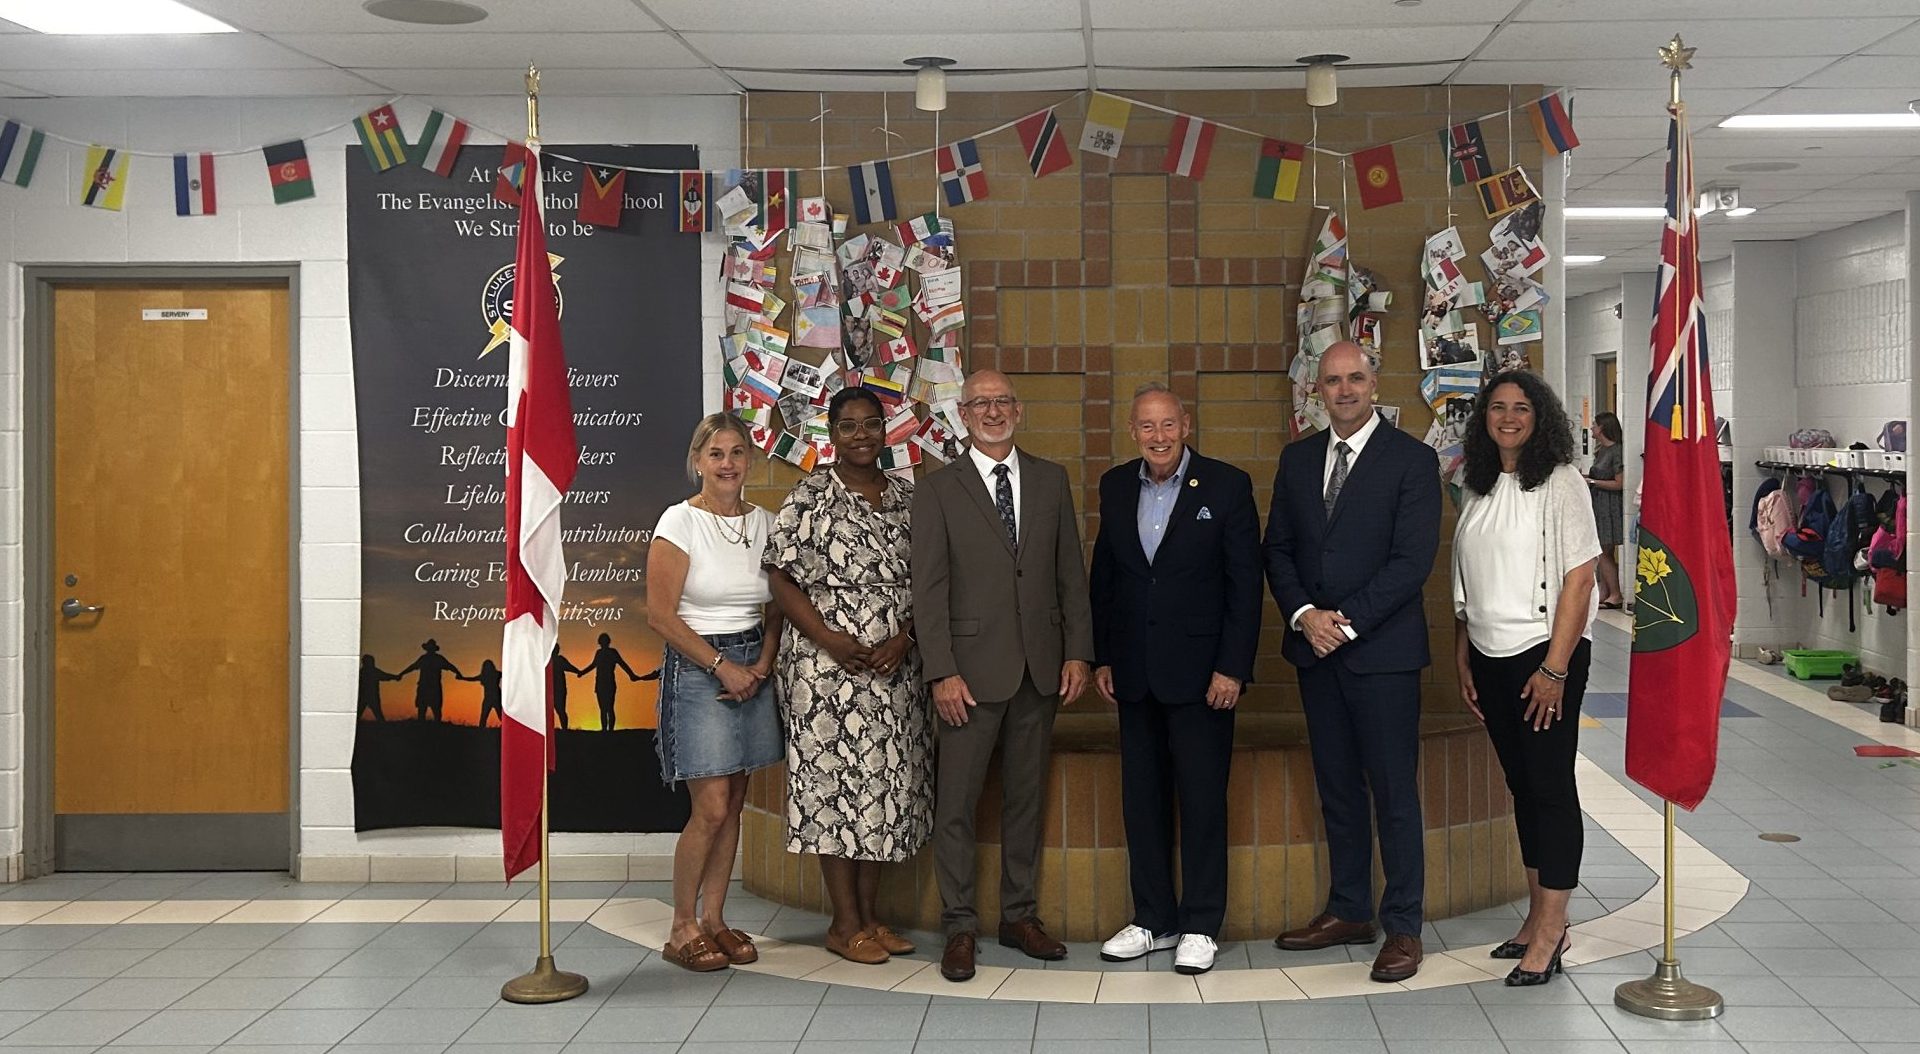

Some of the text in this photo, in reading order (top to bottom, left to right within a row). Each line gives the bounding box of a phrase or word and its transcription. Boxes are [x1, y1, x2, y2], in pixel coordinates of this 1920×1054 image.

[468, 166, 491, 183] At
[541, 166, 573, 183] uke
[376, 192, 413, 210] The
[544, 192, 579, 210] thol
[624, 192, 663, 210] hool
[454, 219, 594, 237] We Stri to be
[433, 367, 620, 388] Discern lievers
[410, 406, 493, 434] Effective
[440, 444, 617, 472] Reflecti kers
[443, 483, 612, 511] Lifelo rners
[404, 522, 652, 544] Collaborat ntributors
[414, 561, 481, 588] Caring
[432, 600, 507, 628] Respons
